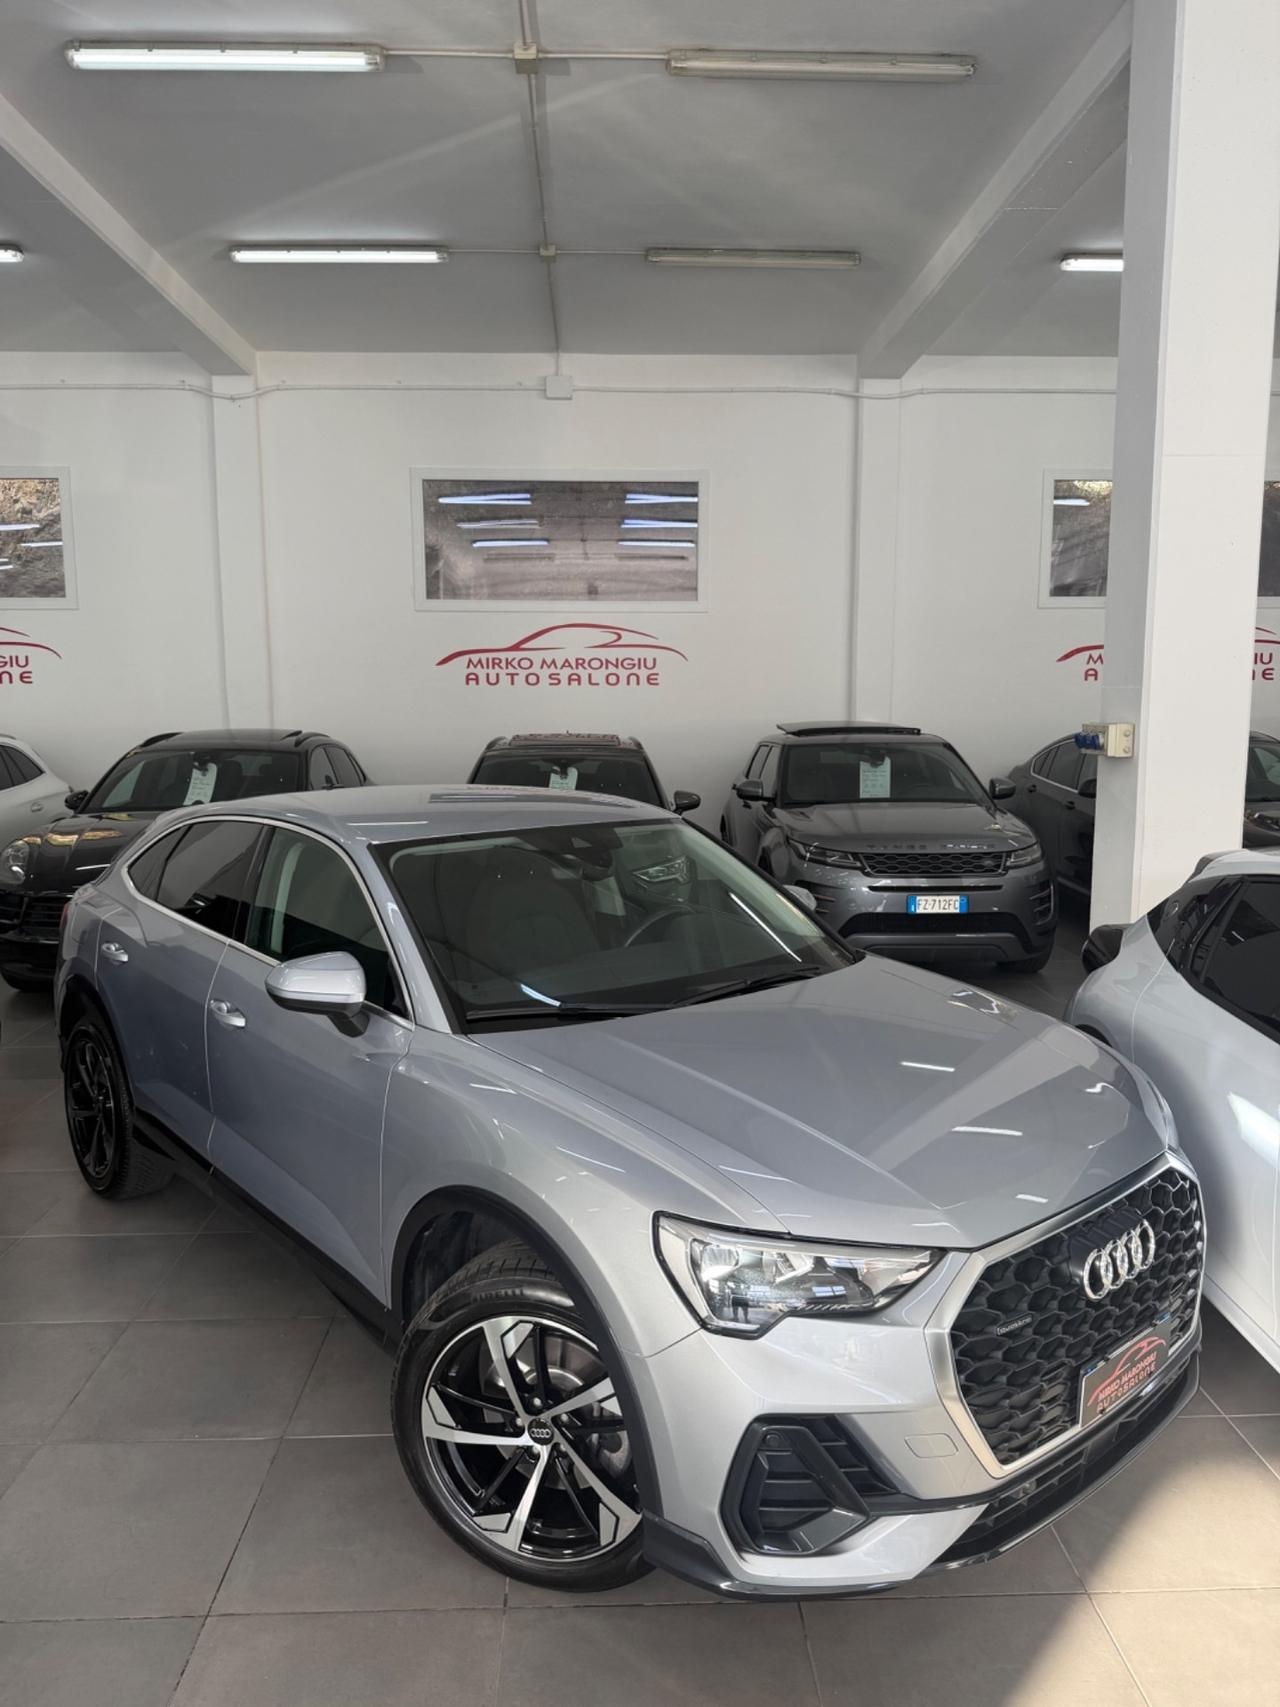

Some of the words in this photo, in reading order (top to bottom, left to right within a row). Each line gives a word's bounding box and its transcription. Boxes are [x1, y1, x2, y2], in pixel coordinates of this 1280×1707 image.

[466, 656, 534, 670] MIRKO
[540, 656, 657, 670] MARONGIU
[465, 672, 660, 686] AUTOSALONE
